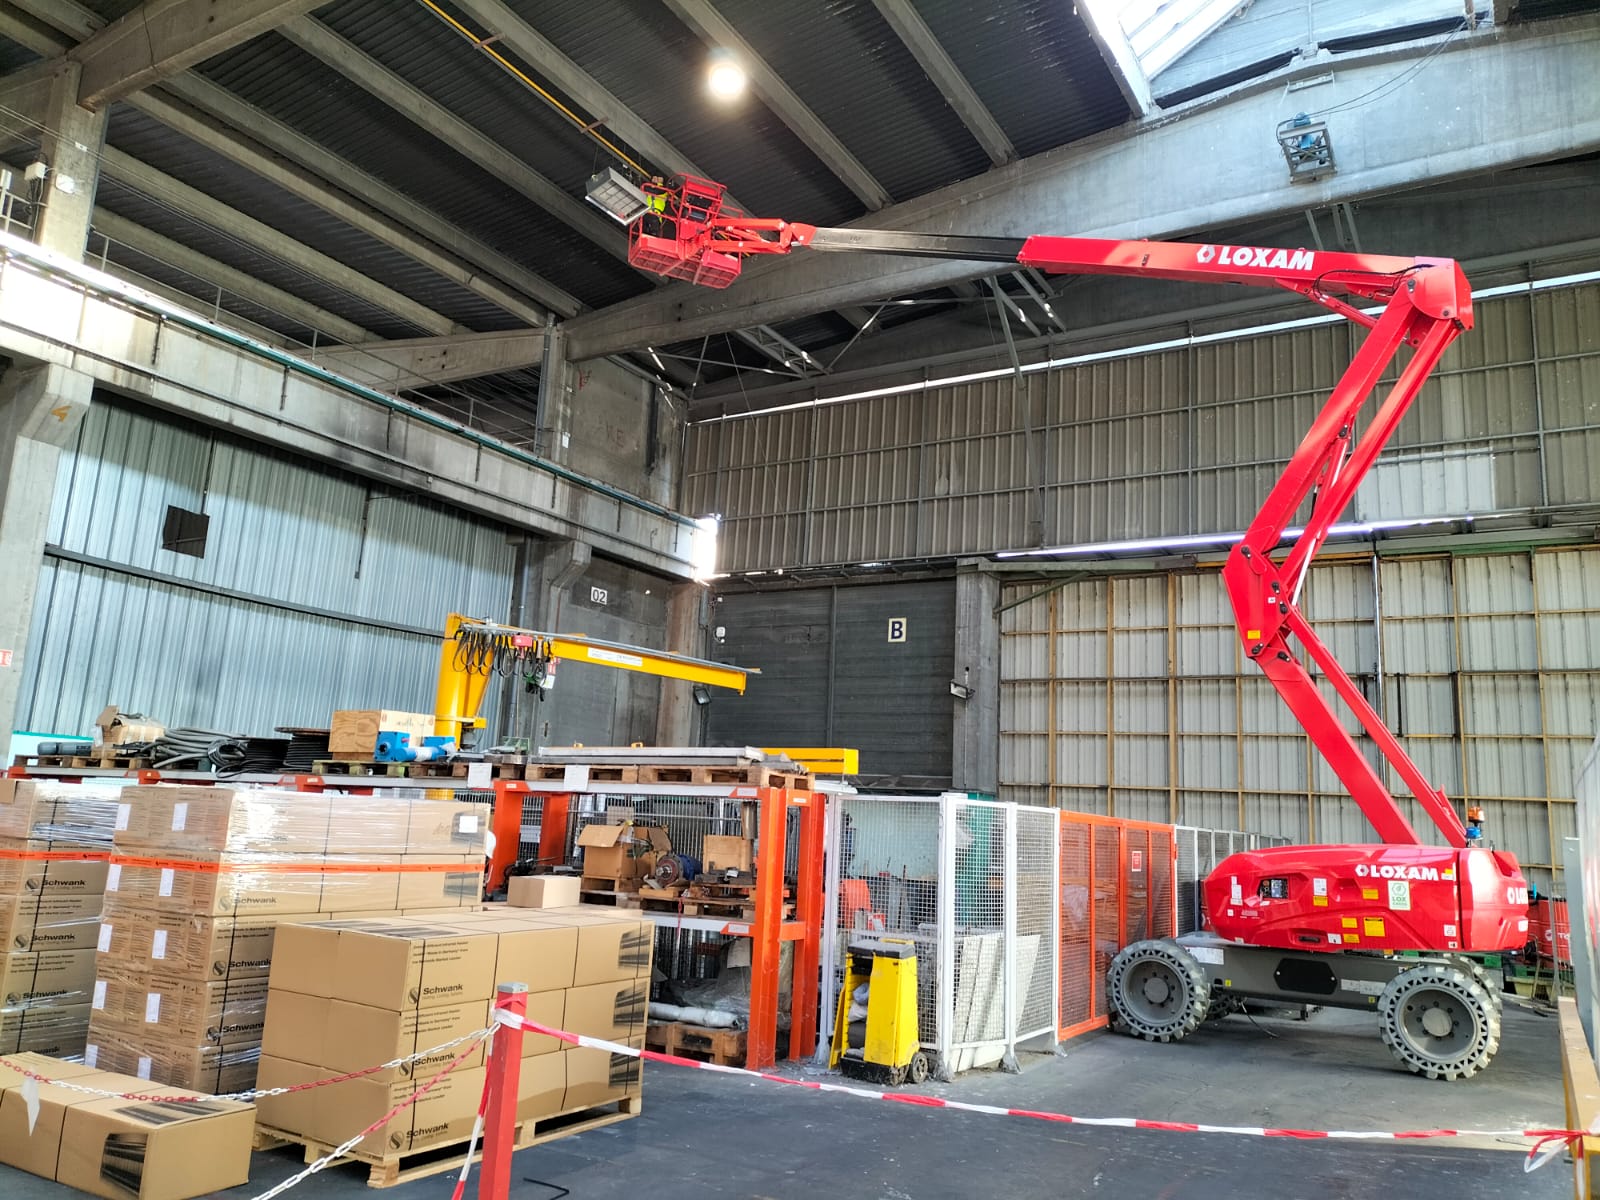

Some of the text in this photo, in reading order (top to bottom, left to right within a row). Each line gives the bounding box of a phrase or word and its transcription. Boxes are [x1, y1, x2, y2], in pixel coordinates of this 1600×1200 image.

[1218, 245, 1315, 271] LOXAM
[593, 589, 606, 603] 02
[891, 620, 903, 640] B
[1370, 864, 1439, 881] LOXAM
[43, 879, 86, 887] Schwank
[33, 933, 76, 941] Schwank
[423, 983, 464, 995] Schwank
[414, 1052, 455, 1066] Schwank
[406, 1122, 449, 1139] Schwank
